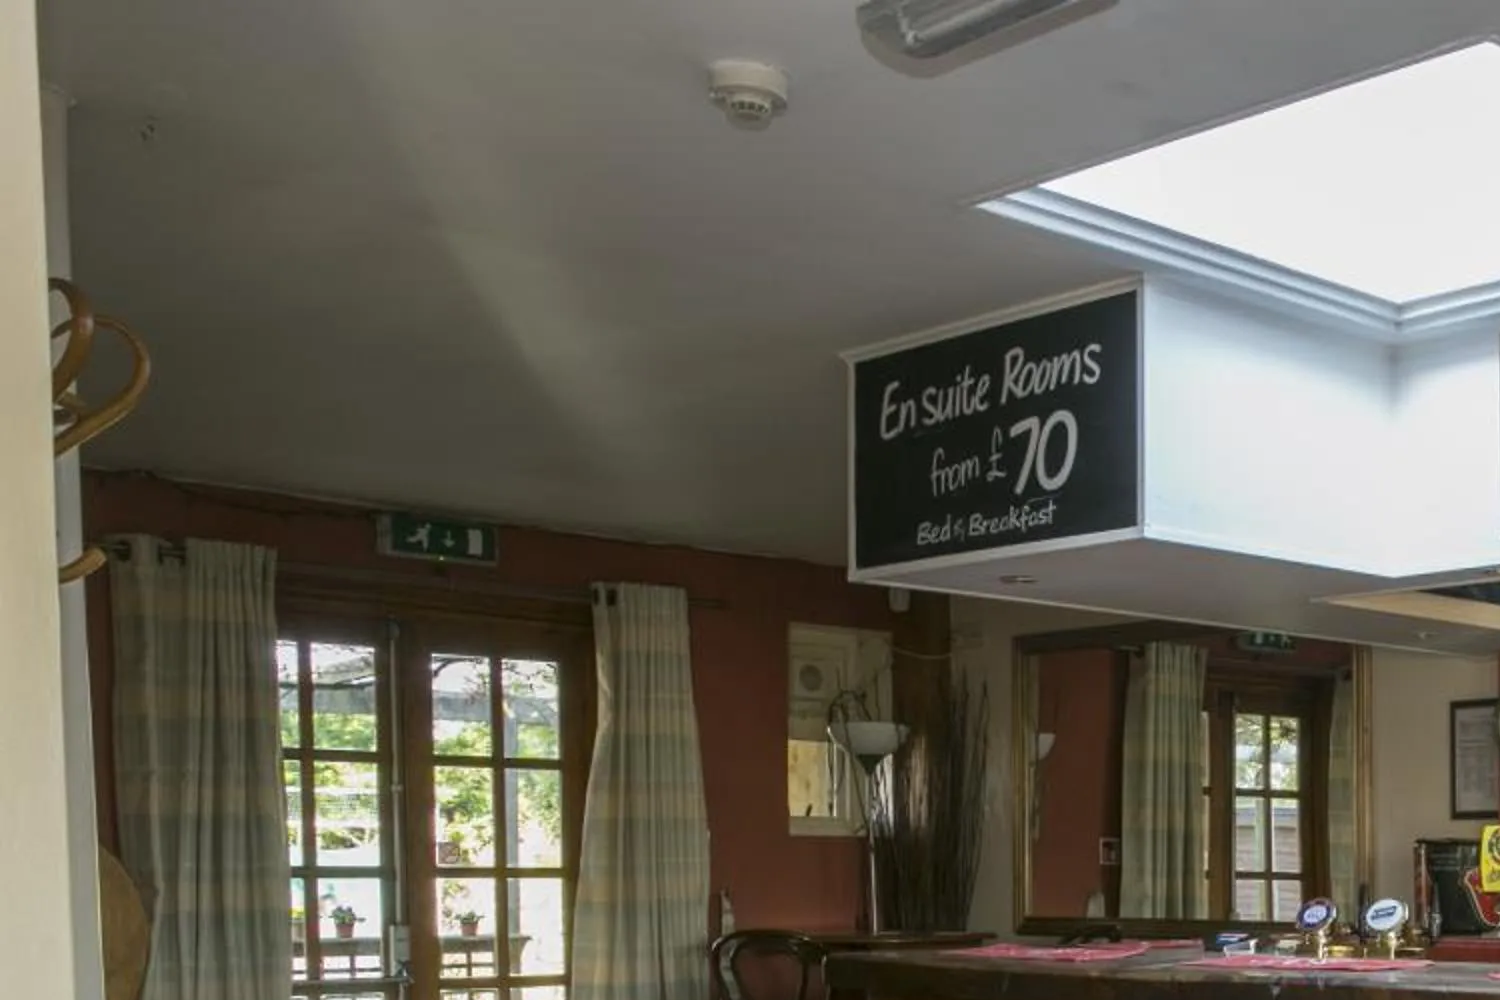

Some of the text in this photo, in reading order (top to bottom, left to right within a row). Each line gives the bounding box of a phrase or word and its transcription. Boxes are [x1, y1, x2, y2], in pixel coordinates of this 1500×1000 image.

[1000, 343, 1102, 405] Rooms
[930, 447, 980, 497] from
[917, 514, 951, 546] Bed
[968, 500, 1057, 538] Breakfast
